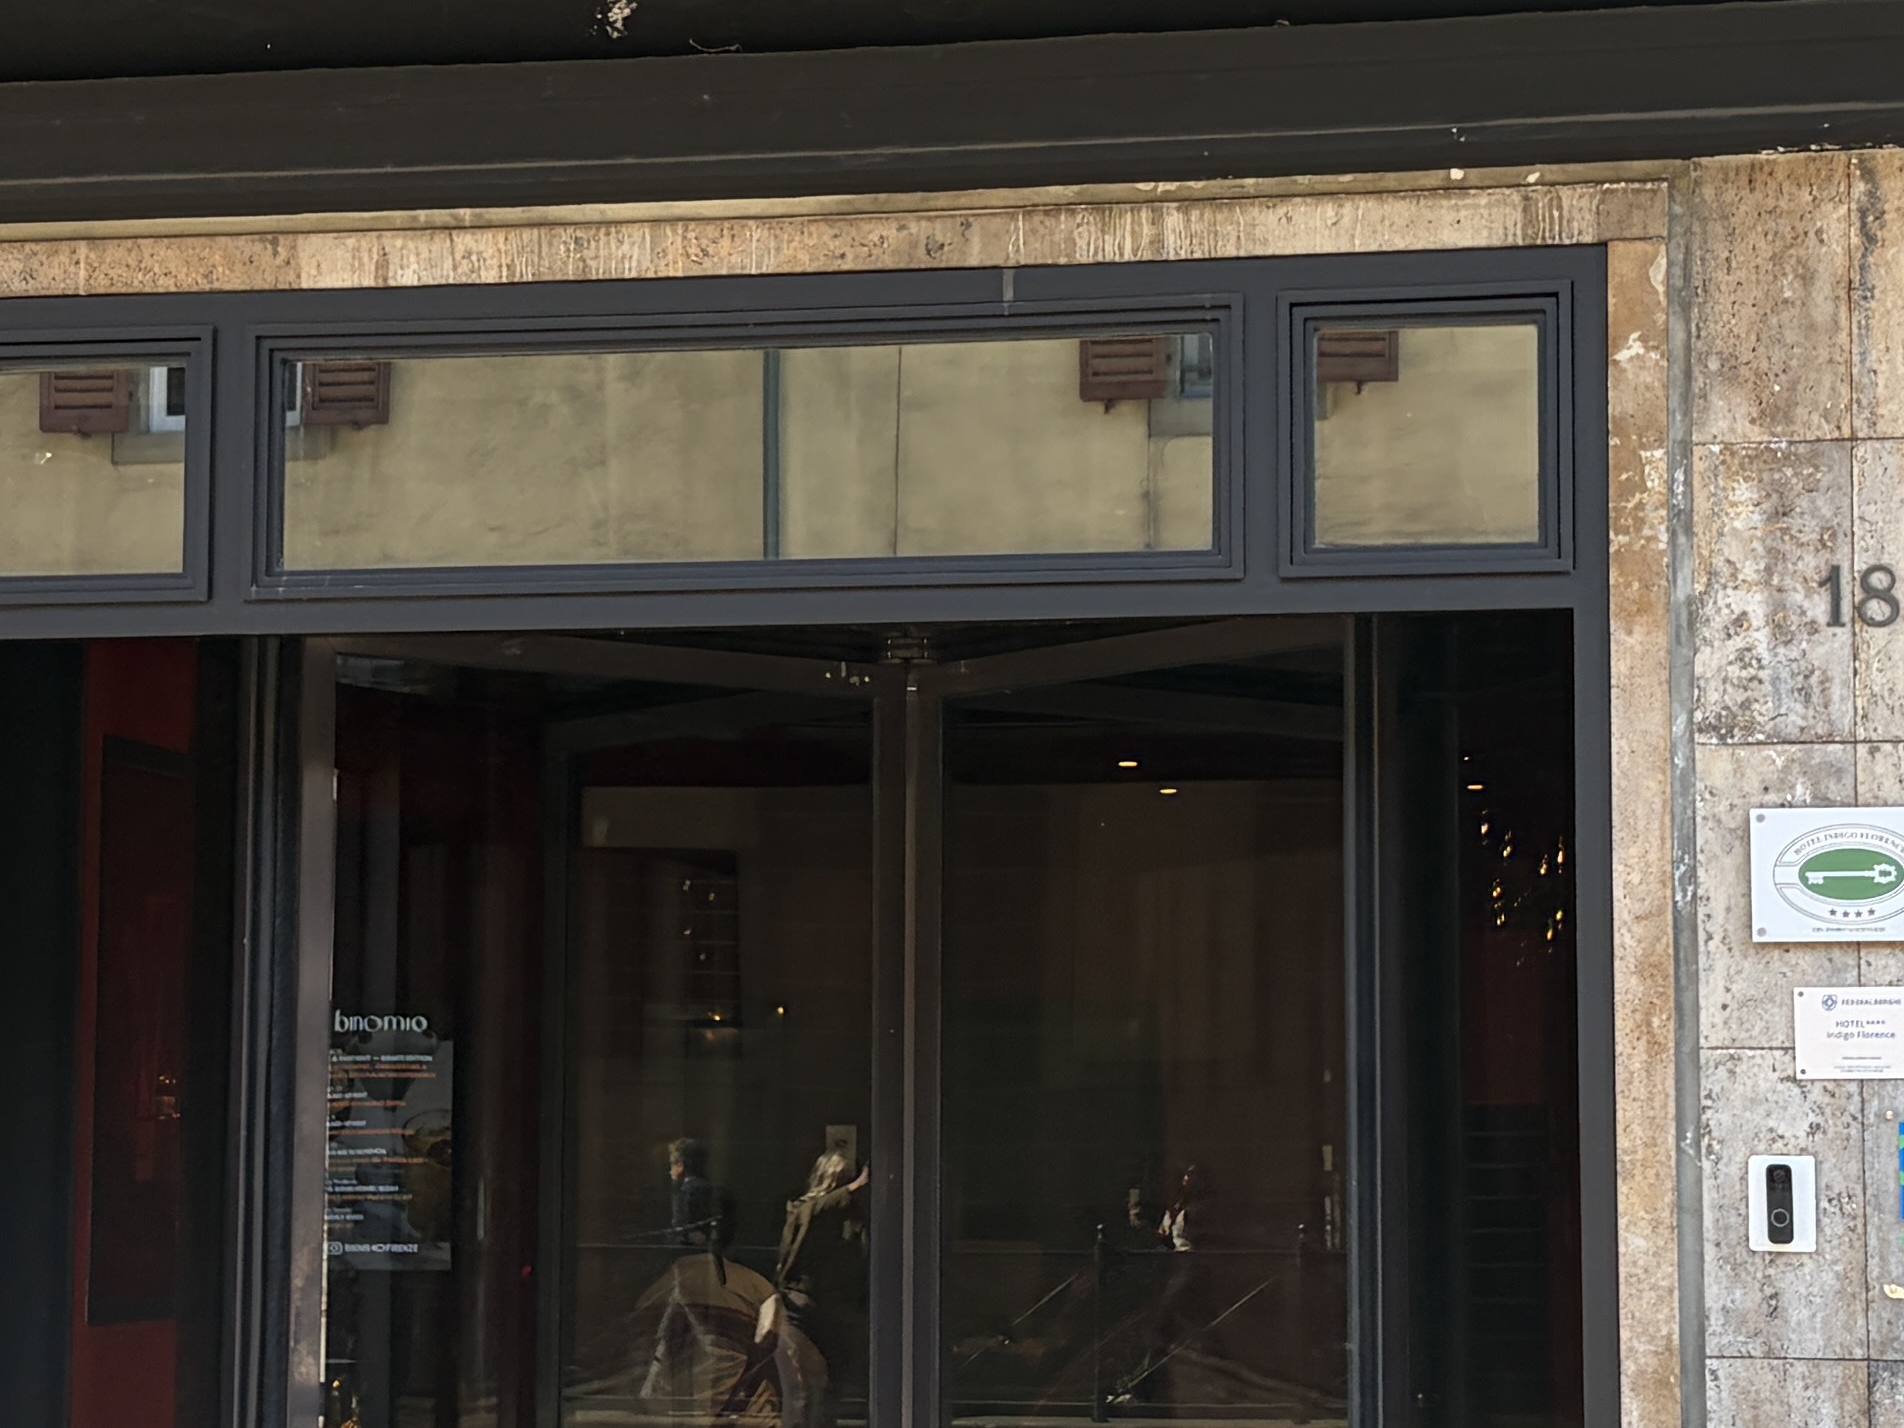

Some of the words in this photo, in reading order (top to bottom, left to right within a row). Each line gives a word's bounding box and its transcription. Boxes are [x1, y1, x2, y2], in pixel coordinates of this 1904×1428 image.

[1816, 563, 1900, 628] 18
[1794, 836, 1822, 855] HOTEL
[333, 1009, 428, 1032] binomio
